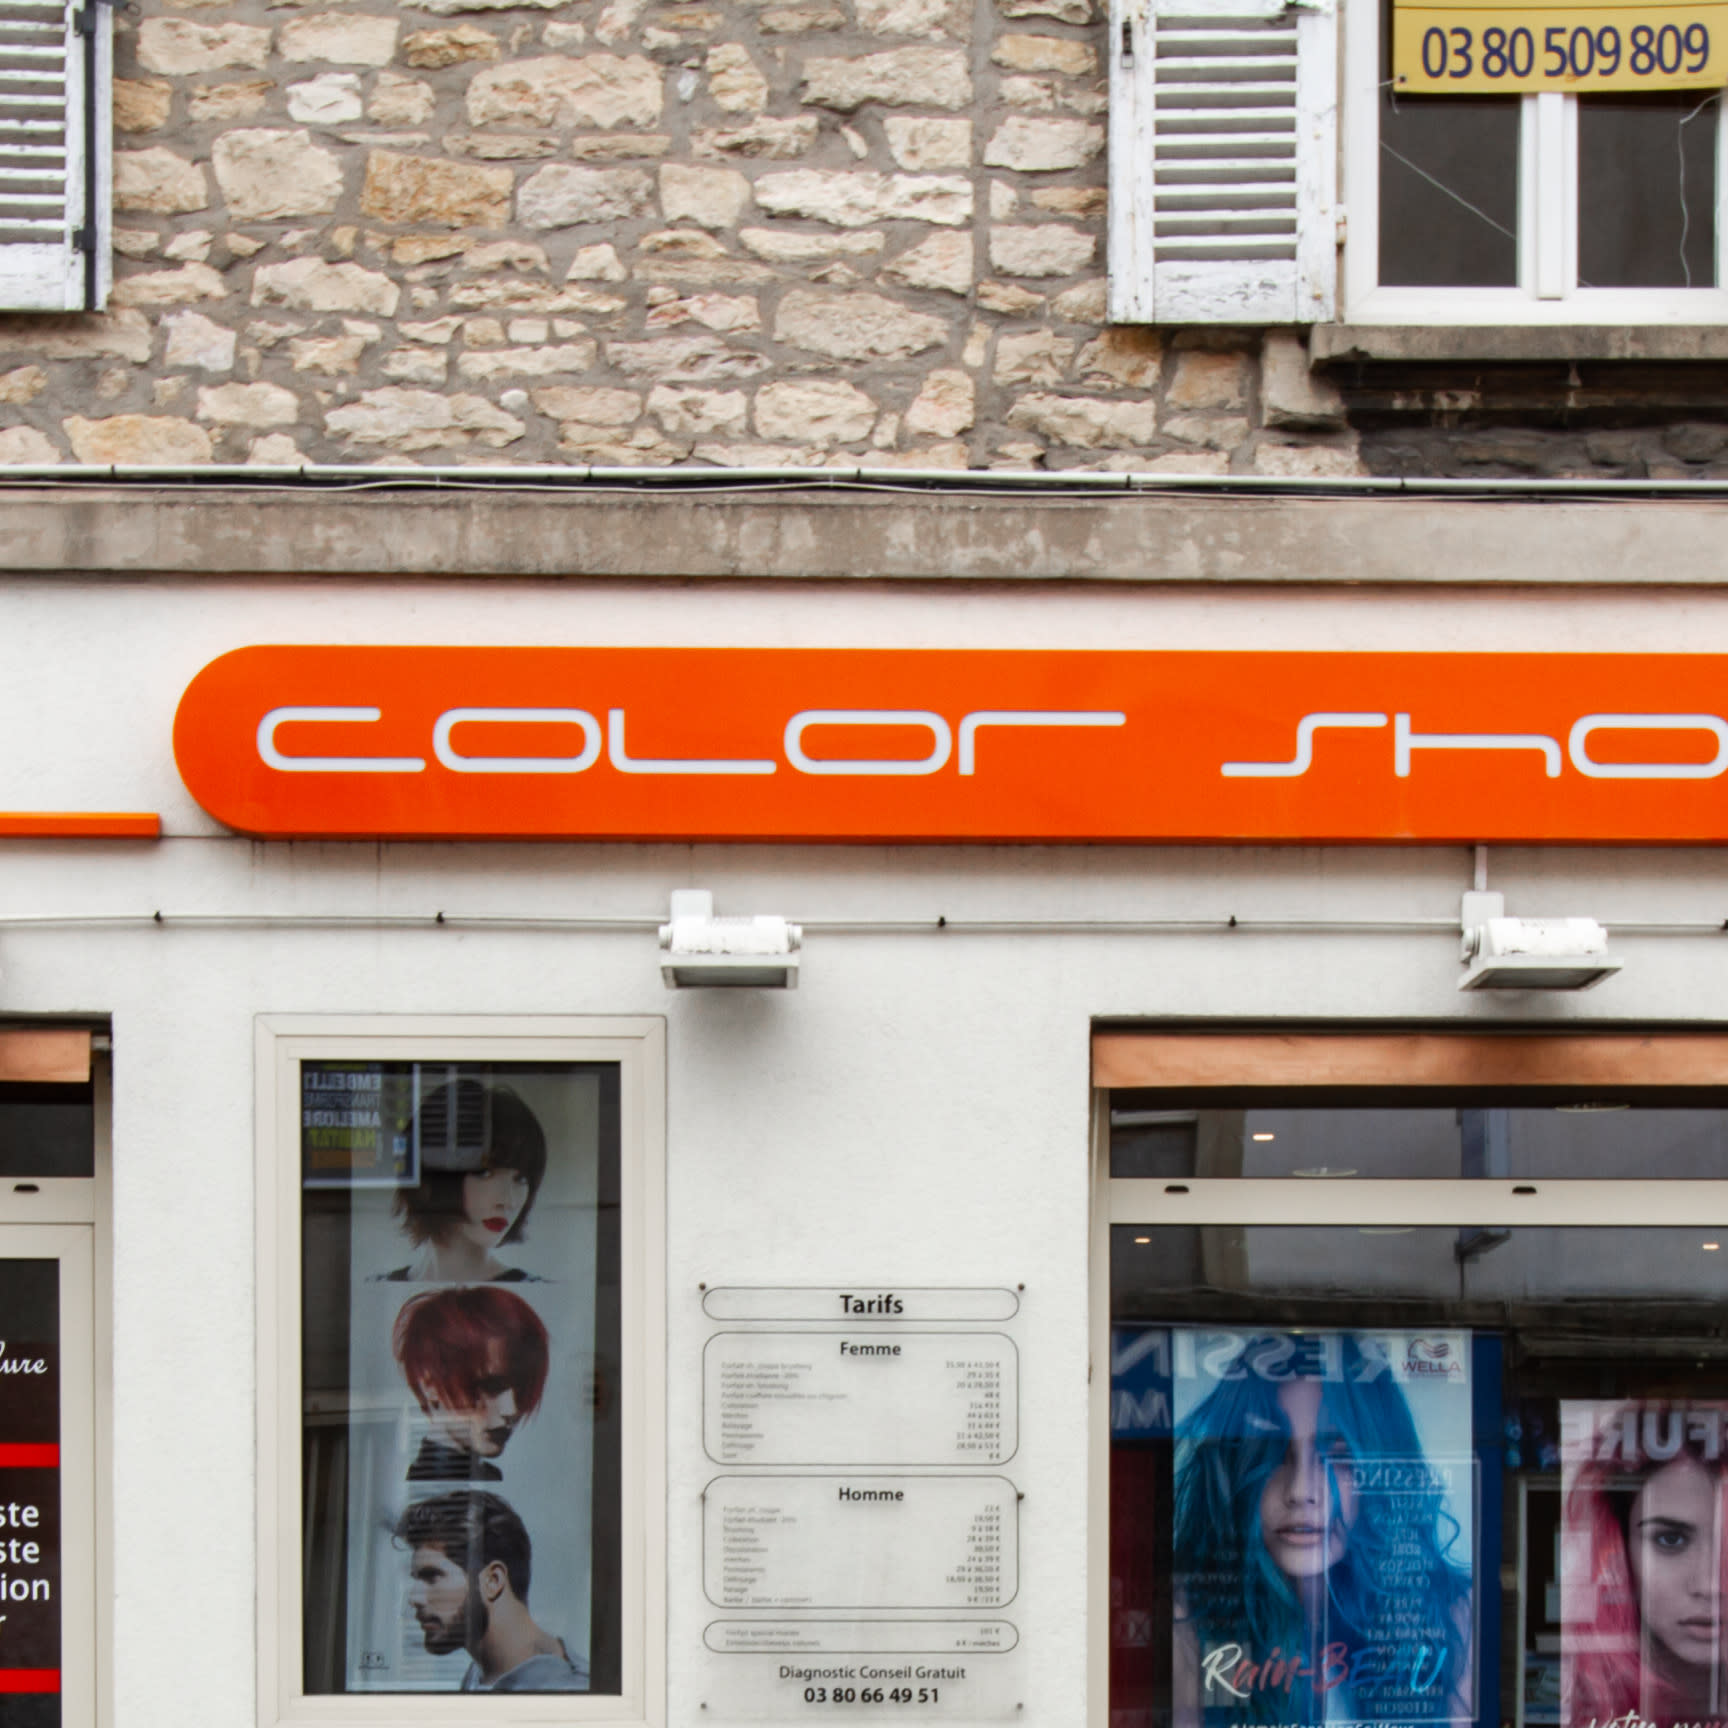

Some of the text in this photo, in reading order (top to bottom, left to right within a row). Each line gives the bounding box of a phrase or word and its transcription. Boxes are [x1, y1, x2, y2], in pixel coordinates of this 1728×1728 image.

[1422, 23, 1709, 78] 03 80 509 809
[840, 1294, 904, 1315] Tarifs
[840, 1342, 902, 1357] Femme
[1402, 1361, 1460, 1374] WELLA
[839, 1487, 904, 1502] Homme
[779, 1666, 966, 1681] Diagnostic Conseil Gratuit
[804, 1688, 939, 1704] 03 80 66 49 51
